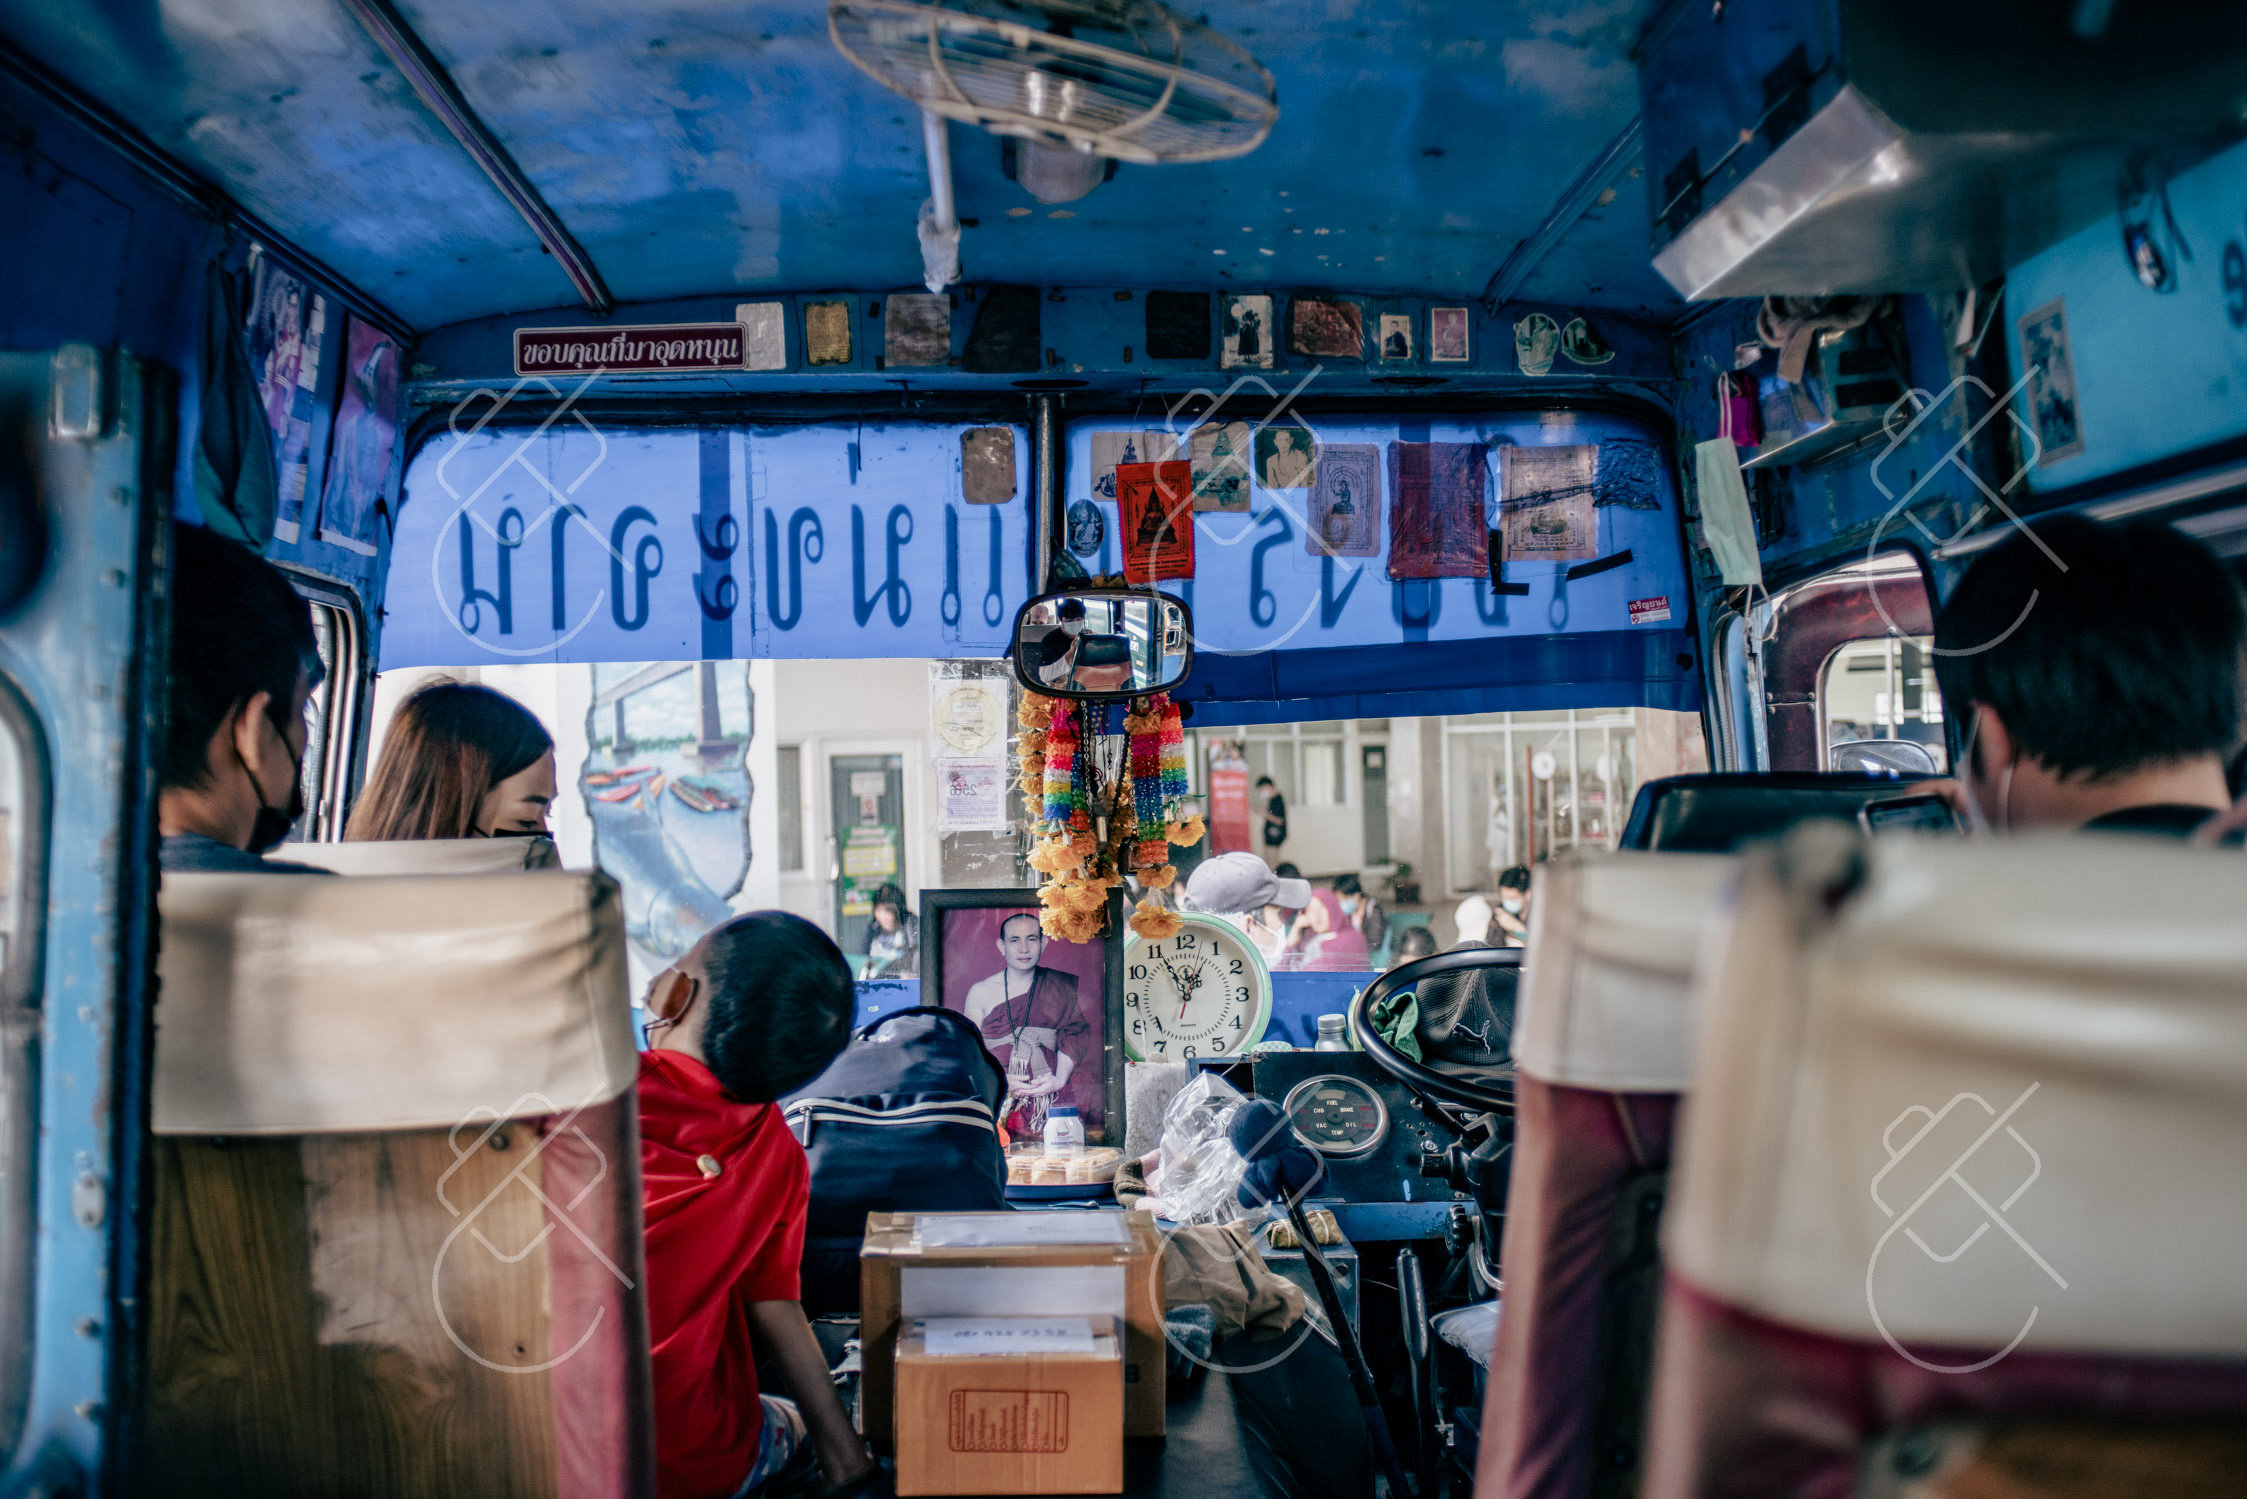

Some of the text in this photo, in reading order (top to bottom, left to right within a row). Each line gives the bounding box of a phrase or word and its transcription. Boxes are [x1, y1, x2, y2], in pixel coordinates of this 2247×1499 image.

[523, 331, 739, 368] ขอบคุณที่มาอุดหนุน
[1629, 596, 1668, 612] เจริญยนต์
[1175, 934, 1196, 950] 12
[1212, 941, 1220, 956] 1
[1147, 944, 1162, 959] 11
[1128, 965, 1147, 980] 10
[1229, 960, 1243, 975] 2
[1126, 993, 1139, 1007] 9
[1236, 987, 1250, 1002] 3
[1133, 1019, 1147, 1035] 8
[1228, 1015, 1242, 1030] 4
[1154, 1040, 1167, 1053] 7
[1212, 1036, 1226, 1052] 5
[1183, 1045, 1196, 1060] 6
